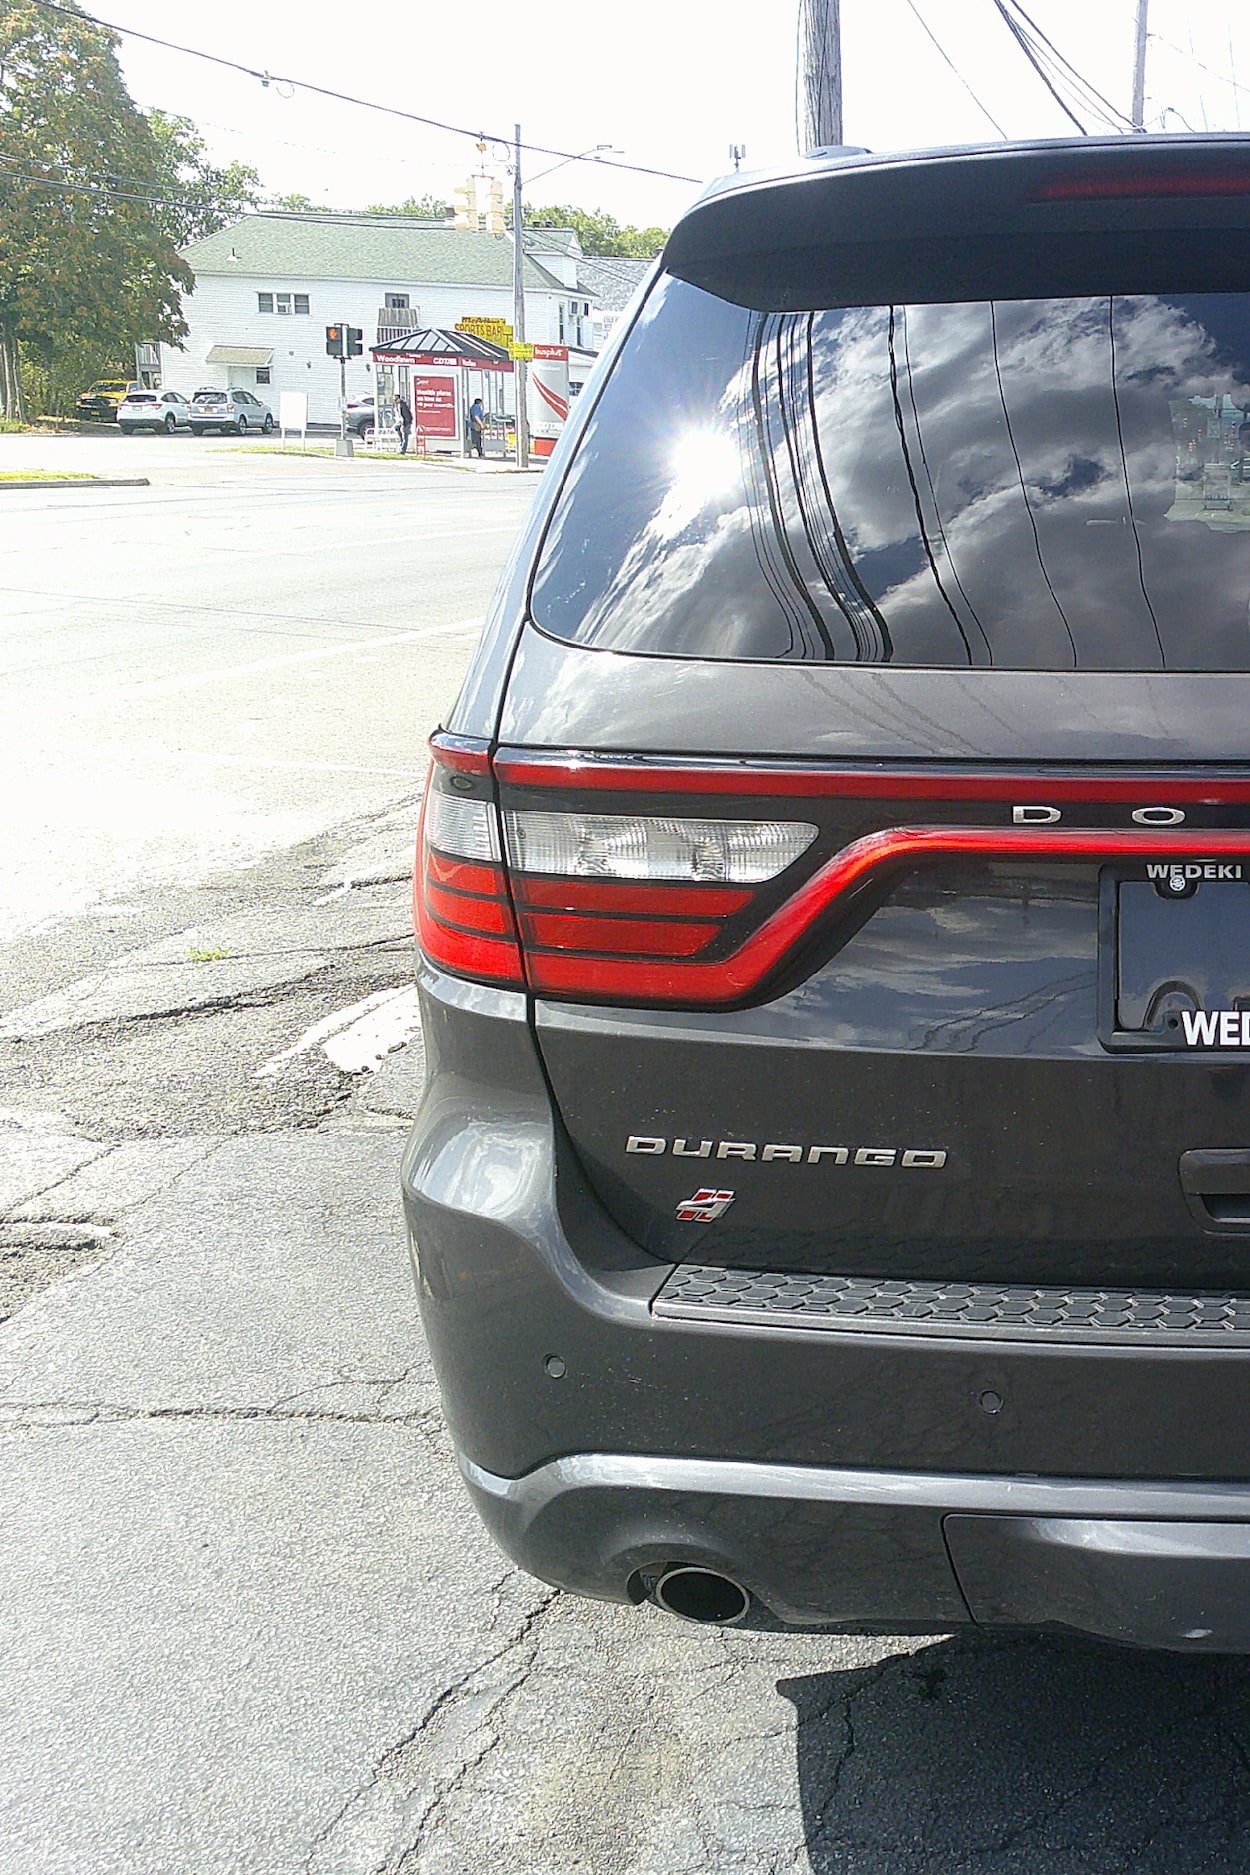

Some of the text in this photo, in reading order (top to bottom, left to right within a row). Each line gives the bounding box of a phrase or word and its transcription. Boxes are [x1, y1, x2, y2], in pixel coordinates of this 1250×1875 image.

[455, 323, 485, 336] SPORTS
[376, 354, 416, 364] Woodlawn
[625, 1135, 948, 1169] DURANGO
